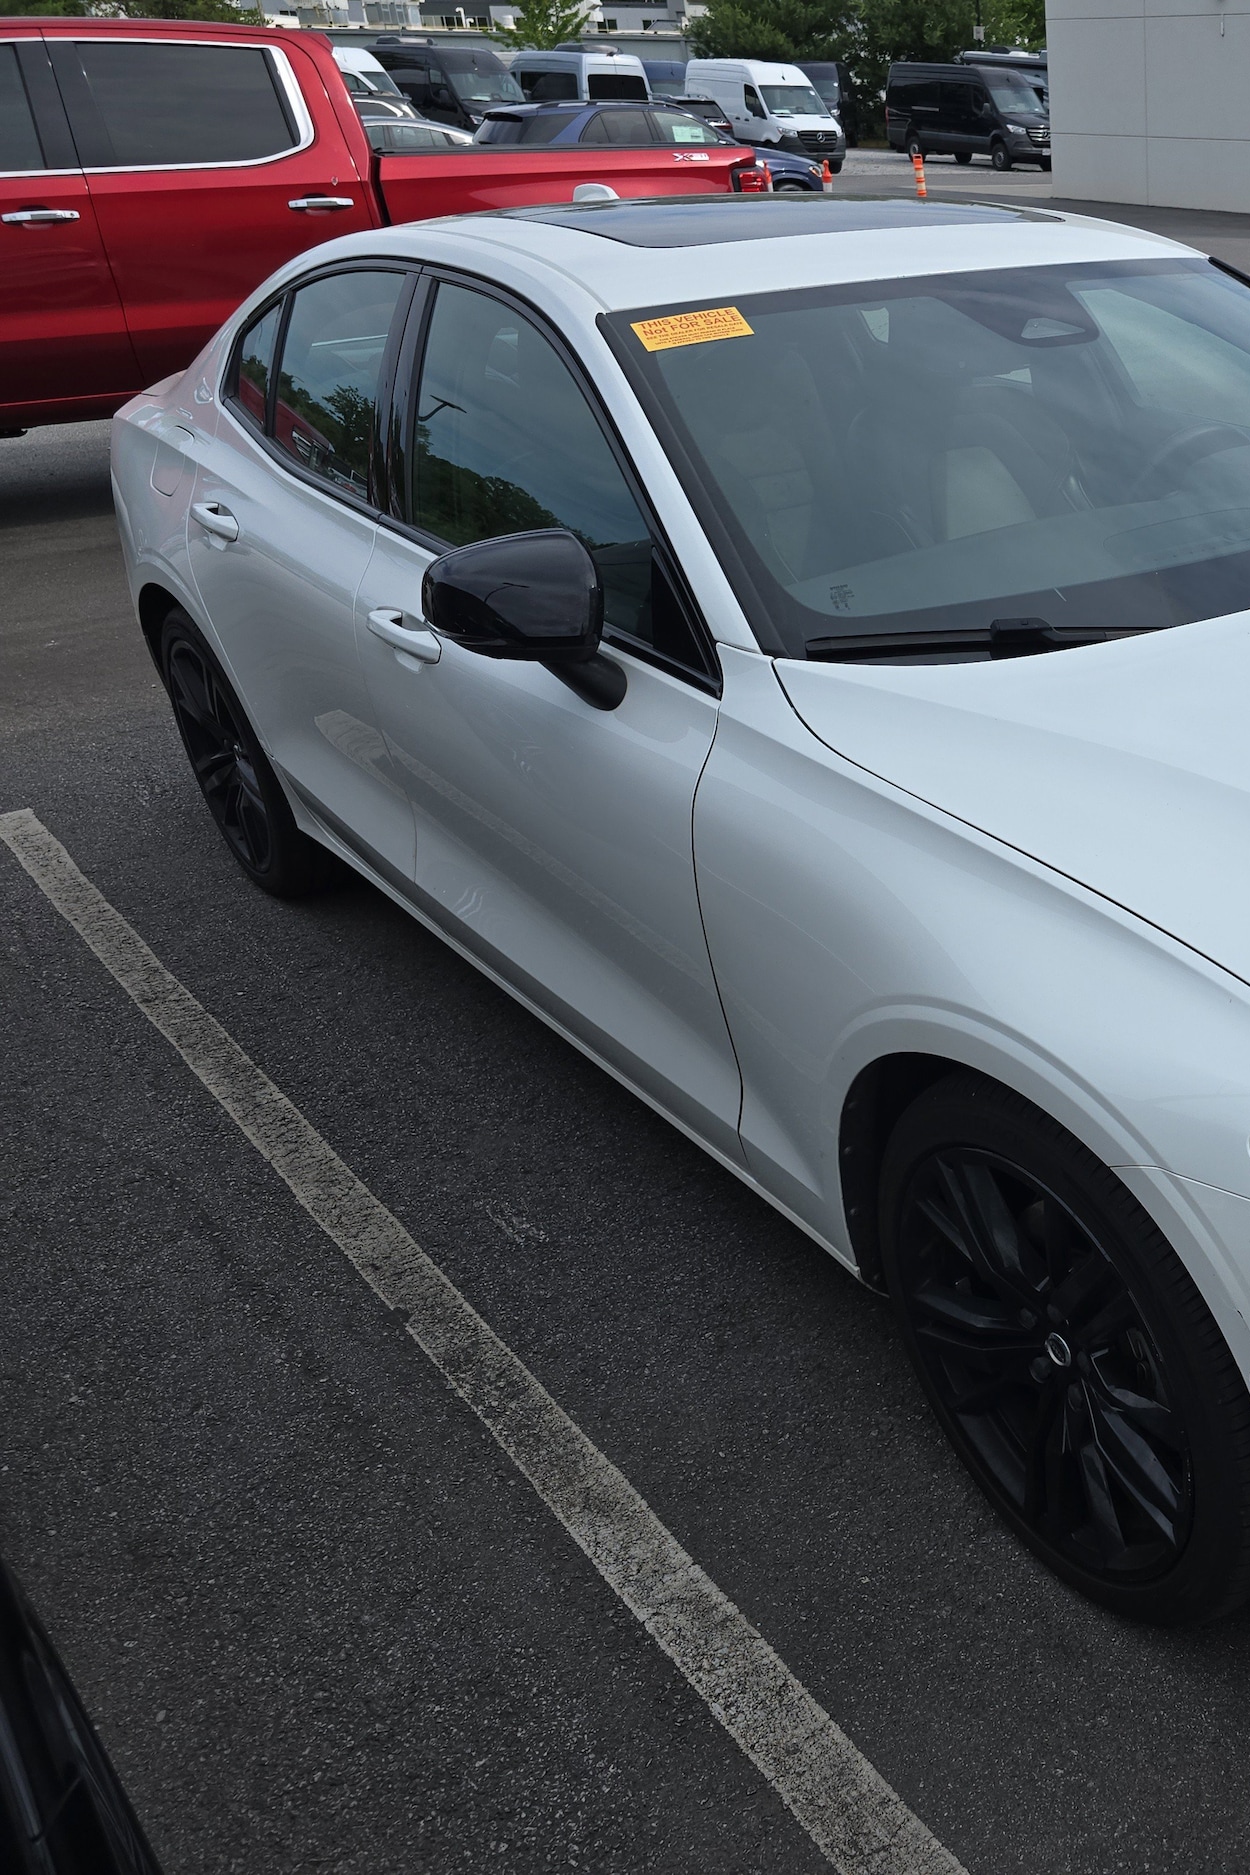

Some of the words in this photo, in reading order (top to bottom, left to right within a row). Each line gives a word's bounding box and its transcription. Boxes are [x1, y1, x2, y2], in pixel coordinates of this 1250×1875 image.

[639, 319, 671, 329] THIS
[673, 309, 734, 323] VEHICLE
[643, 327, 668, 336] Not
[670, 321, 700, 330] FOR
[703, 315, 741, 325] SALE
